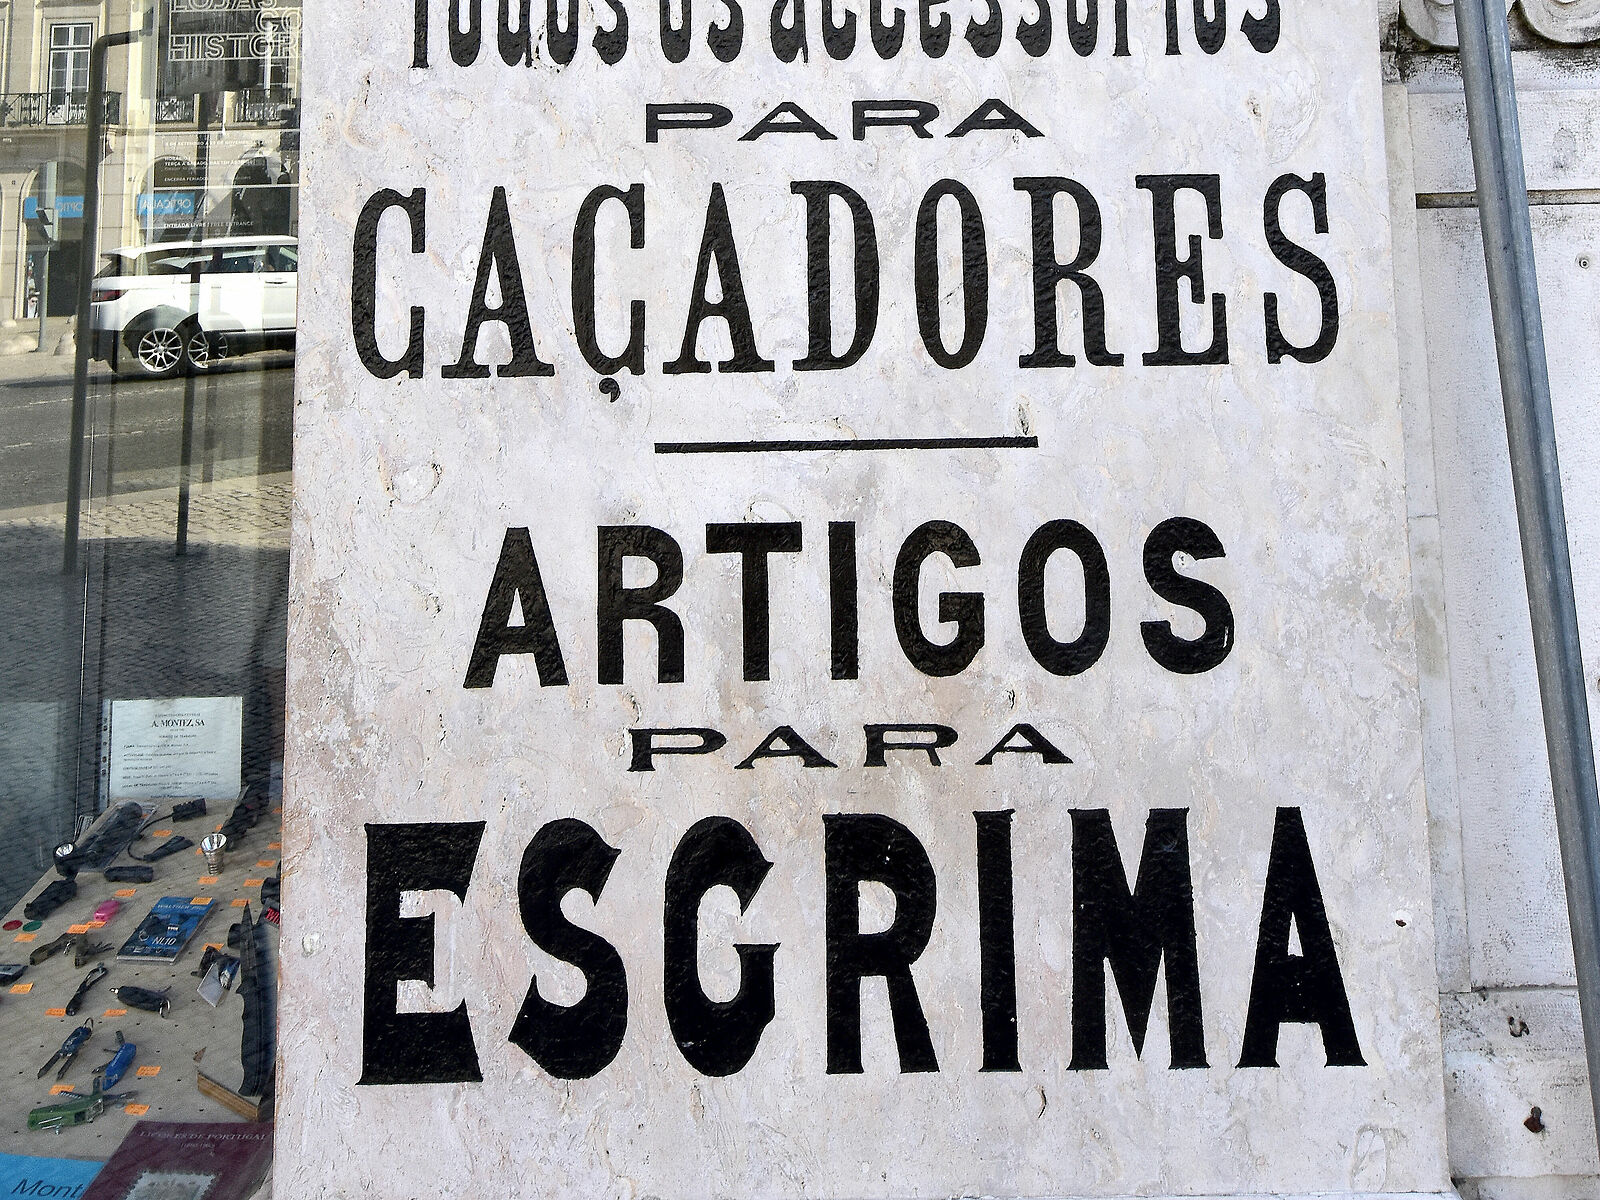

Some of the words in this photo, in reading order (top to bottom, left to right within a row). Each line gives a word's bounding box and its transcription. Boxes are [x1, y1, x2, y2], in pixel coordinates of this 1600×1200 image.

[646, 98, 1046, 144] PARA
[351, 172, 1339, 404] CAÇADORES
[463, 517, 1234, 689] ARTIGOS
[627, 723, 1073, 773] PARA
[355, 806, 1368, 1086] ESGRIMA
